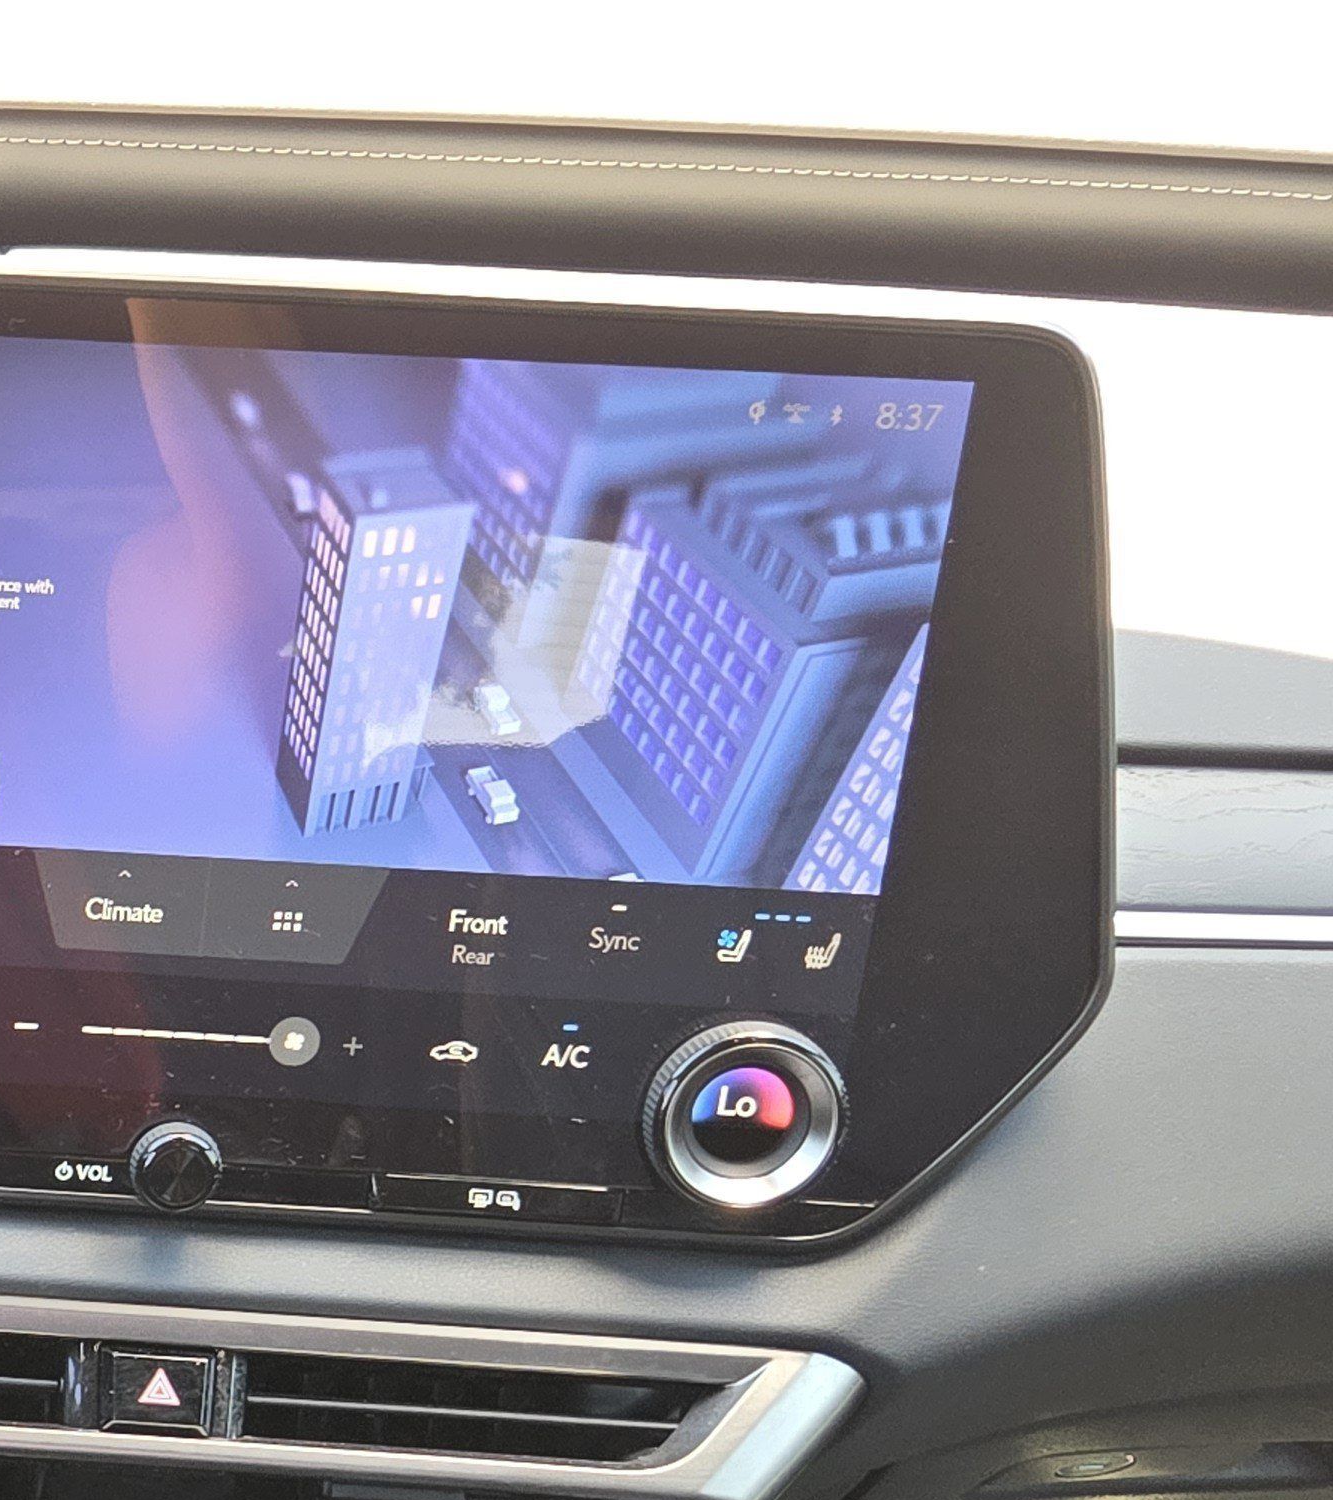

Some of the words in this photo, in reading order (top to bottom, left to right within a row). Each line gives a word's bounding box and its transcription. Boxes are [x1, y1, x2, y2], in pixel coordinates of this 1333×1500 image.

[875, 402, 945, 431] 8:37
[25, 578, 54, 595] with
[85, 897, 164, 924] Climate
[448, 908, 508, 936] Front
[589, 927, 641, 954] Sync
[452, 944, 495, 966] Rear
[541, 1043, 591, 1070] A/C
[715, 1085, 758, 1118] Lo
[75, 1163, 113, 1183] VOL
